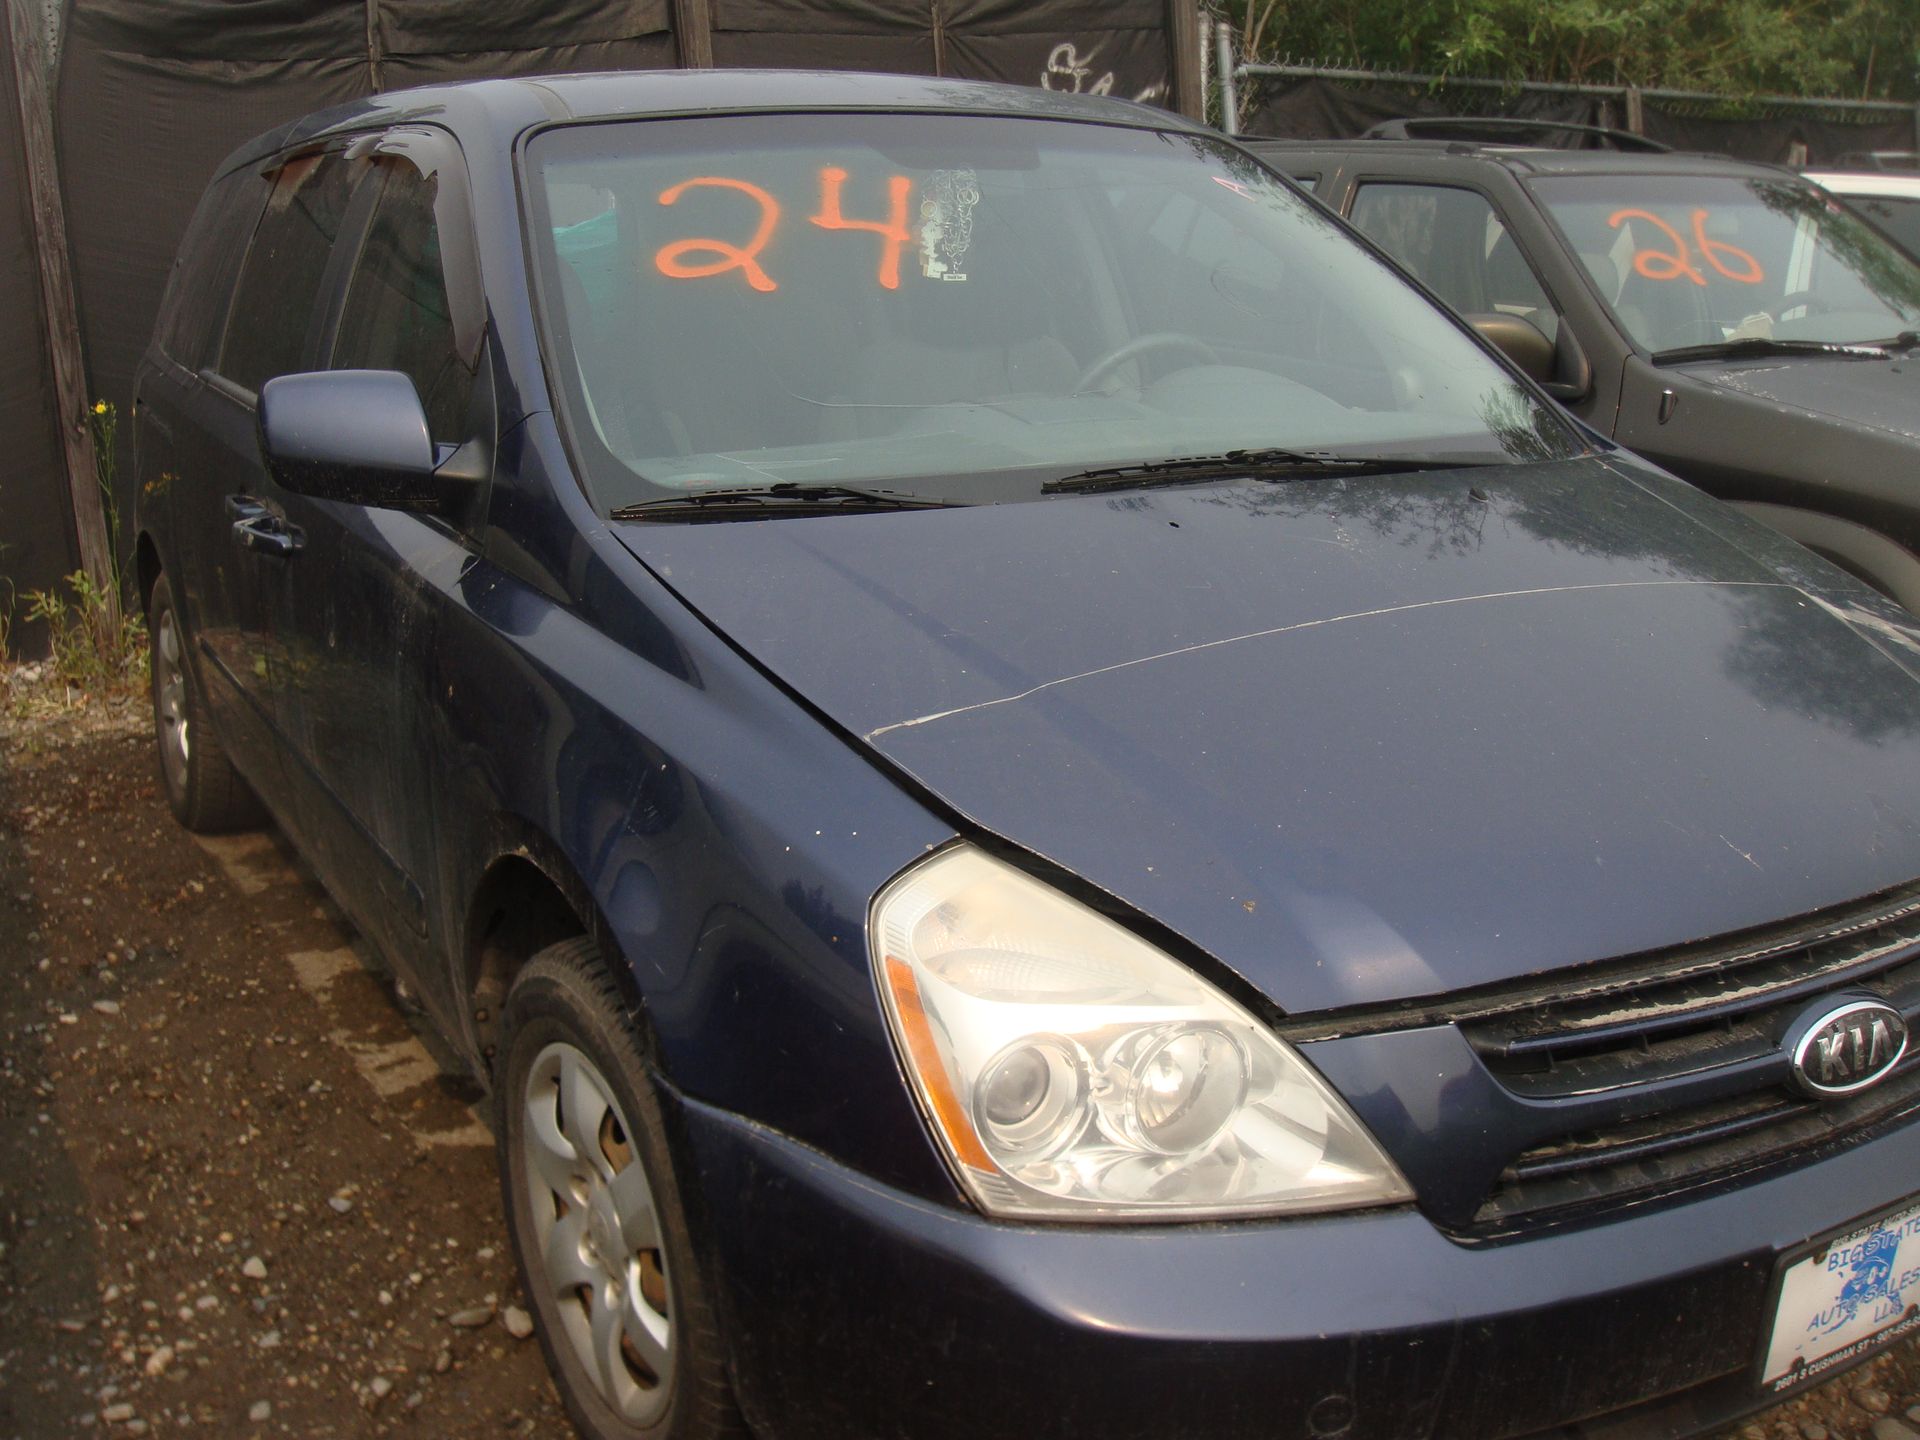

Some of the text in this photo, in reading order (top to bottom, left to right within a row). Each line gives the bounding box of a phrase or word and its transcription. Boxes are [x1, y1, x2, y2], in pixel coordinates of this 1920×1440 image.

[655, 166, 911, 292] 24
[1607, 208, 1764, 287] 26
[1817, 1019, 1894, 1081] KIA
[1827, 1214, 1920, 1272] BIG STATE
[1806, 1293, 1860, 1331] AUTO
[1861, 1266, 1920, 1303] SALES
